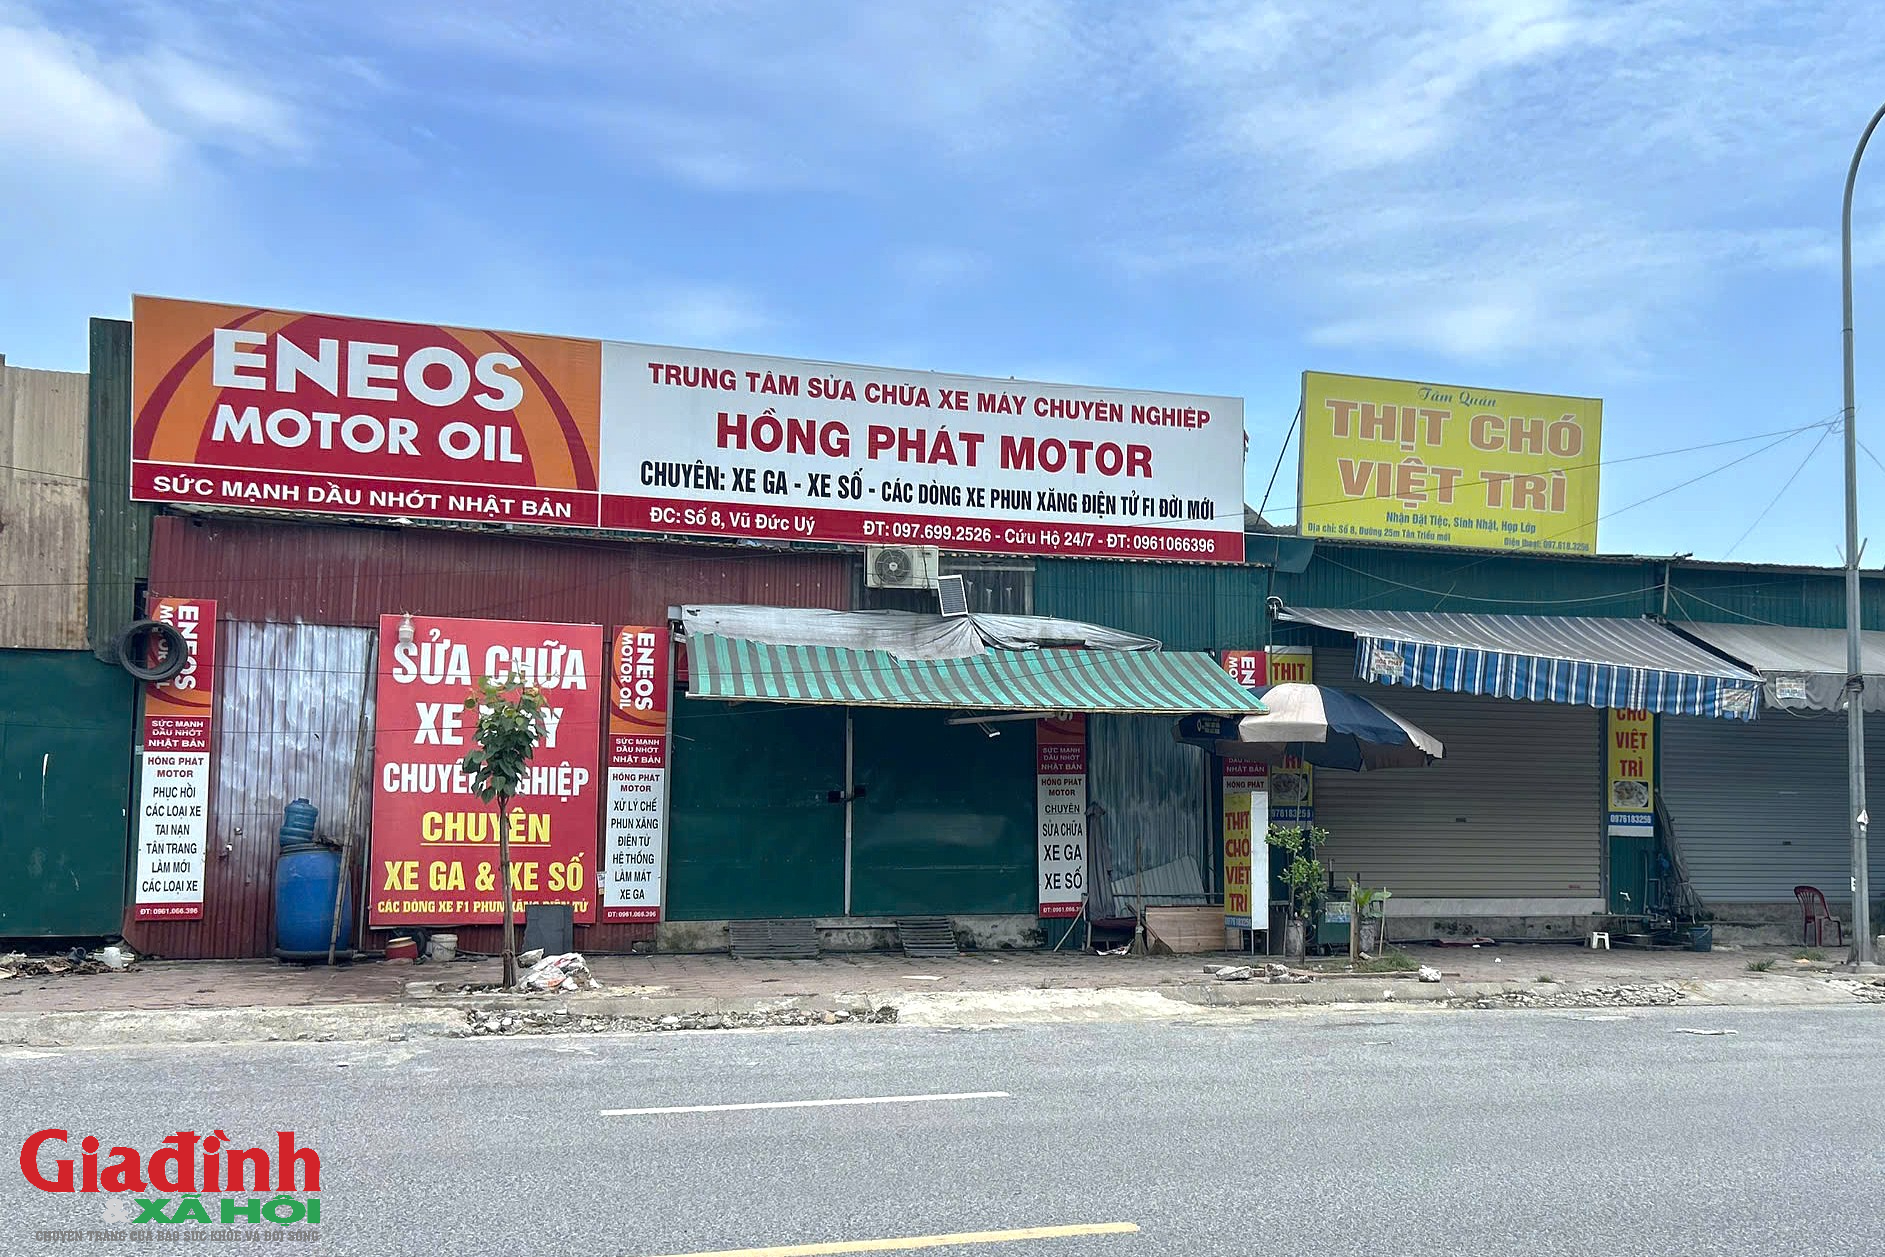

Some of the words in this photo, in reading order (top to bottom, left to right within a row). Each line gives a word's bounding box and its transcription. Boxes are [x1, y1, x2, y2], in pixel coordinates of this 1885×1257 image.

[213, 328, 523, 411] ENEOS
[648, 362, 737, 391] TRUNG
[746, 371, 799, 396] TÂM
[808, 374, 857, 401] SỬA
[865, 381, 931, 409] CHỮA
[938, 389, 969, 411] XE
[977, 391, 1027, 415] MÁY
[1034, 396, 1124, 423] CHUYÊN
[1131, 405, 1211, 431] NGHIỆP
[211, 404, 422, 456] MOTOR
[438, 421, 523, 463] OIL
[1325, 398, 1452, 452] THỊT
[1469, 413, 1583, 459] CHÓ
[717, 407, 850, 458] HỒNG
[868, 424, 985, 467] PHÁT
[1000, 435, 1153, 479] MOTOR
[153, 474, 214, 496] SỨC
[222, 480, 300, 504] MẠNH
[307, 482, 361, 506] DẦU
[370, 488, 439, 511] NHỚT
[448, 493, 516, 518] NHẬT
[522, 496, 572, 519] BẢN
[640, 459, 726, 492] CHUYÊN:
[732, 467, 757, 494] XE
[763, 470, 788, 496] GA
[808, 472, 831, 498] XE
[838, 468, 864, 500] SỐ
[882, 477, 913, 503] CÁC
[919, 480, 961, 507] DÒNG
[966, 487, 985, 508] XE
[990, 489, 1032, 511] PHUN
[1036, 488, 1077, 513] XĂNG
[1082, 490, 1116, 519] ĐIỆN
[1121, 489, 1139, 517] TỬ
[1143, 497, 1154, 518] FI
[1159, 494, 1182, 519] ĐỜI
[1187, 497, 1214, 521] MỚI
[1337, 456, 1463, 510] VIỆT
[1479, 467, 1567, 514] TRÌ
[650, 506, 681, 524] ĐC:
[684, 507, 707, 526] Số
[711, 510, 725, 529] 8,
[730, 511, 751, 529] Vũ
[755, 512, 790, 531] Đức
[794, 514, 815, 536] Uý
[863, 519, 889, 538] ĐT:
[893, 521, 991, 543] 097.699.2526
[1004, 527, 1036, 546] Cứu
[1040, 531, 1061, 550] Hộ
[1065, 531, 1094, 548] 24/7
[1107, 534, 1131, 550] ĐT:
[1133, 535, 1215, 553] 0961066396
[392, 628, 472, 685] SỬA
[485, 639, 588, 690] CHỮA
[620, 632, 633, 685] MOTOR
[634, 632, 656, 711] ENEOS
[619, 687, 632, 710] OIL
[413, 702, 464, 746] XE
[148, 738, 179, 749] NHẬT
[181, 738, 205, 748] BẢN
[1616, 728, 1647, 753] VIỆT
[613, 755, 639, 765] NHẬT
[1620, 756, 1643, 777] TRÌ
[153, 786, 178, 801] PHỤC
[180, 782, 196, 798] HỒI
[145, 802, 165, 817] CÁC
[167, 805, 188, 820] LOẠI
[189, 805, 202, 817] XE
[640, 797, 657, 812] CHẾ
[1044, 802, 1080, 814] CHUYÊN
[155, 824, 169, 835] TAI
[171, 824, 190, 838] NẠN
[422, 807, 551, 843] CHUYÊN
[611, 818, 634, 829] PHUN
[636, 816, 659, 829] XĂNG
[1042, 819, 1059, 837] SỬA
[166, 842, 197, 855] TRANG
[626, 849, 655, 864] THỐNG
[1044, 845, 1060, 861] XE
[1064, 844, 1082, 861] GA
[151, 859, 170, 873] LÀM
[173, 859, 190, 873] MỚI
[384, 860, 420, 891] XE
[429, 860, 466, 891] GA
[475, 861, 495, 891] &
[510, 861, 539, 891] XE
[548, 852, 585, 892] SỐ
[614, 868, 632, 882] LÀM
[1045, 873, 1061, 889] XE
[1065, 865, 1082, 889] SỐ
[142, 877, 161, 892] CÁC
[163, 881, 184, 895] LOẠI
[186, 880, 198, 892] XE
[620, 889, 631, 900] XE
[633, 889, 645, 900] GA
[377, 898, 400, 913] CÁC
[403, 898, 435, 913] DÒNG
[438, 900, 454, 913] XE
[456, 900, 469, 913] F1
[473, 900, 504, 913] PHUN
